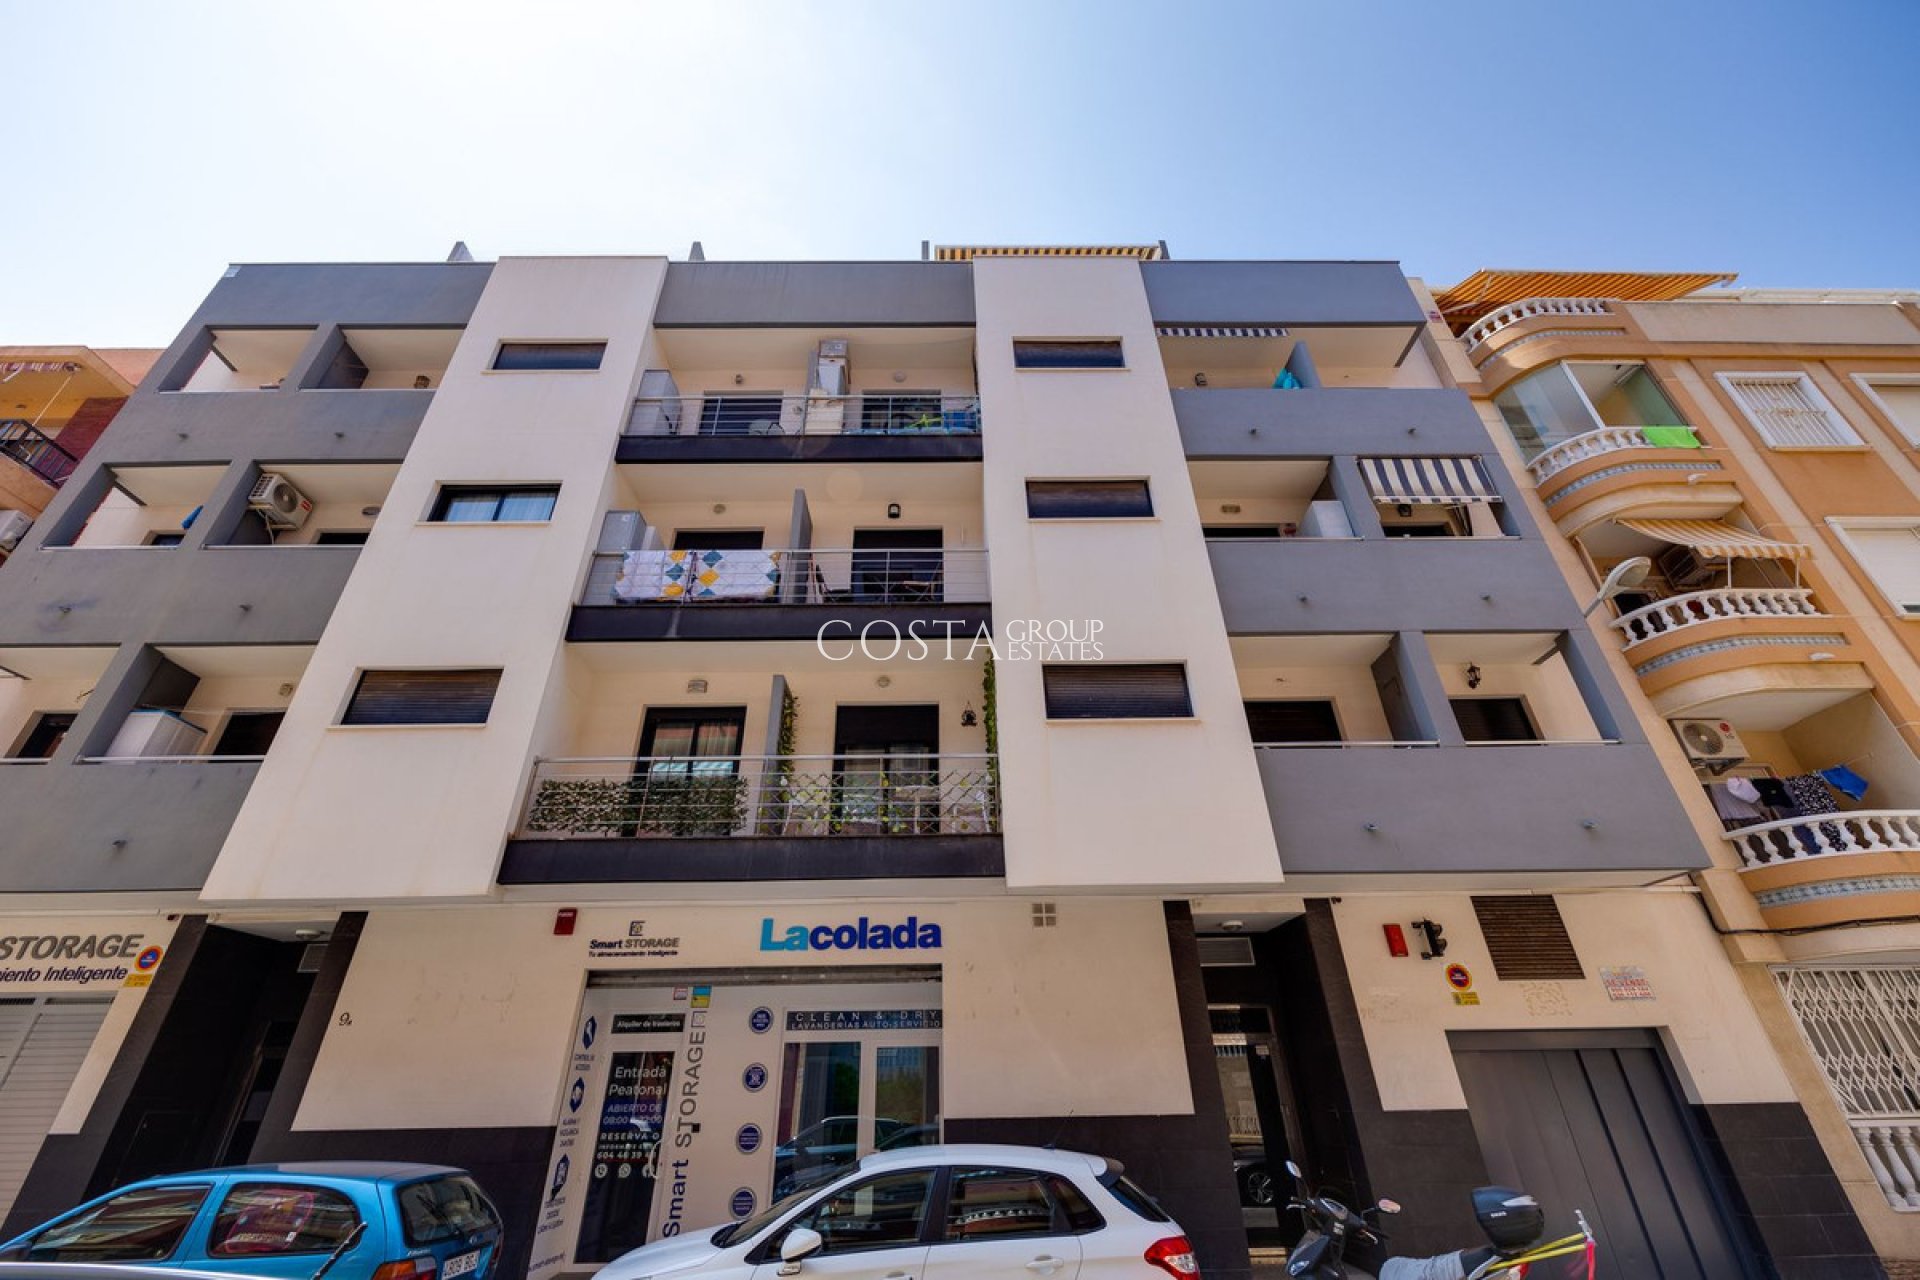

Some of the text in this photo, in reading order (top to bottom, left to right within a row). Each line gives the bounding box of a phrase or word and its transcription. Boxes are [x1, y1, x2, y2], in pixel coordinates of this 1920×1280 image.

[760, 916, 942, 951] Lacolada
[0, 934, 144, 960] STORAGE
[590, 937, 679, 949] Smart STORAGE
[43, 966, 128, 984] Inteligente
[795, 1010, 938, 1022] CLEAN & DRY
[615, 1066, 667, 1078] Entrada
[609, 1082, 668, 1096] Peatonal
[675, 1031, 706, 1148] STORAGE
[607, 1103, 662, 1113] ABIERTO DE
[600, 1132, 648, 1141] RESERVA
[662, 1158, 689, 1238] Smart
